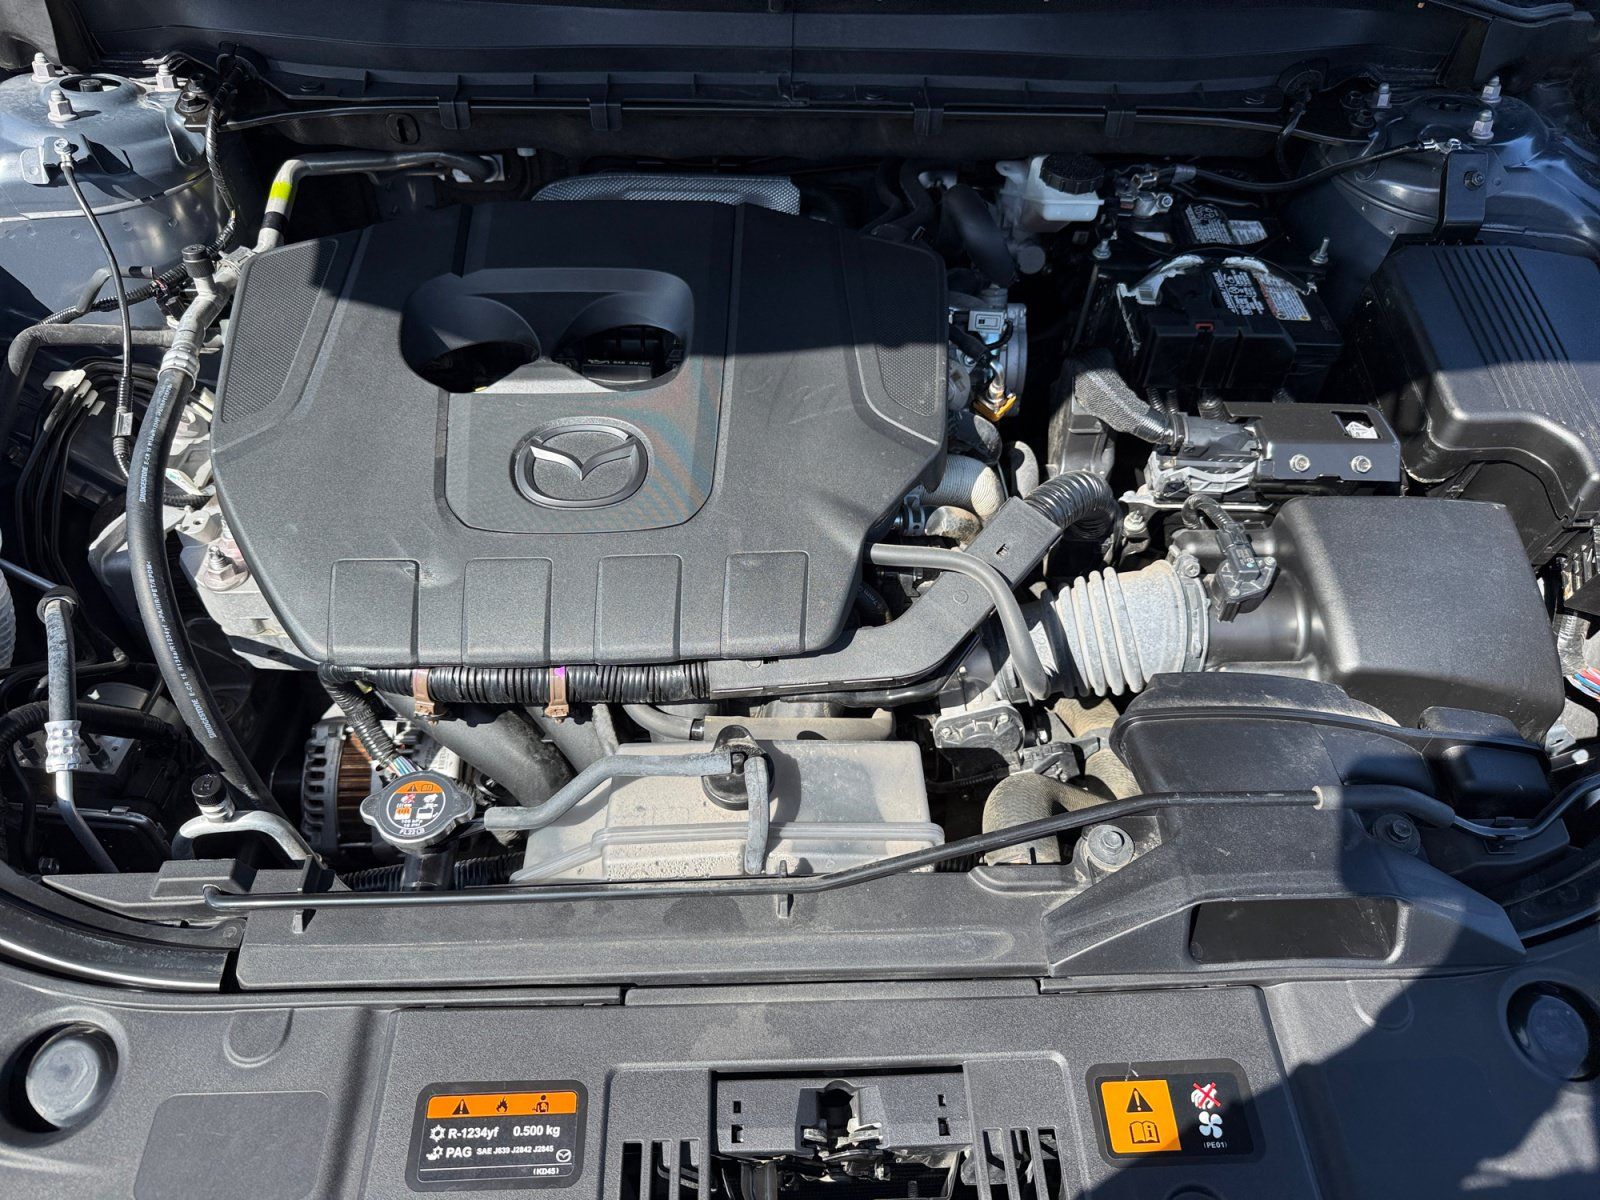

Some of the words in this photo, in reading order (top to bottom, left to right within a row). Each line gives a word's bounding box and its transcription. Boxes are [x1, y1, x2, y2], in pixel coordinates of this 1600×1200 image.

[447, 1126, 499, 1140] R-1234yf
[512, 1125, 544, 1137] 0.500
[545, 1125, 561, 1137] kg
[445, 1146, 473, 1158] PAG
[476, 1147, 493, 1155] SAE
[511, 1146, 532, 1154] J2842
[532, 1145, 554, 1153] J2845
[1203, 1141, 1228, 1149] (PE01)
